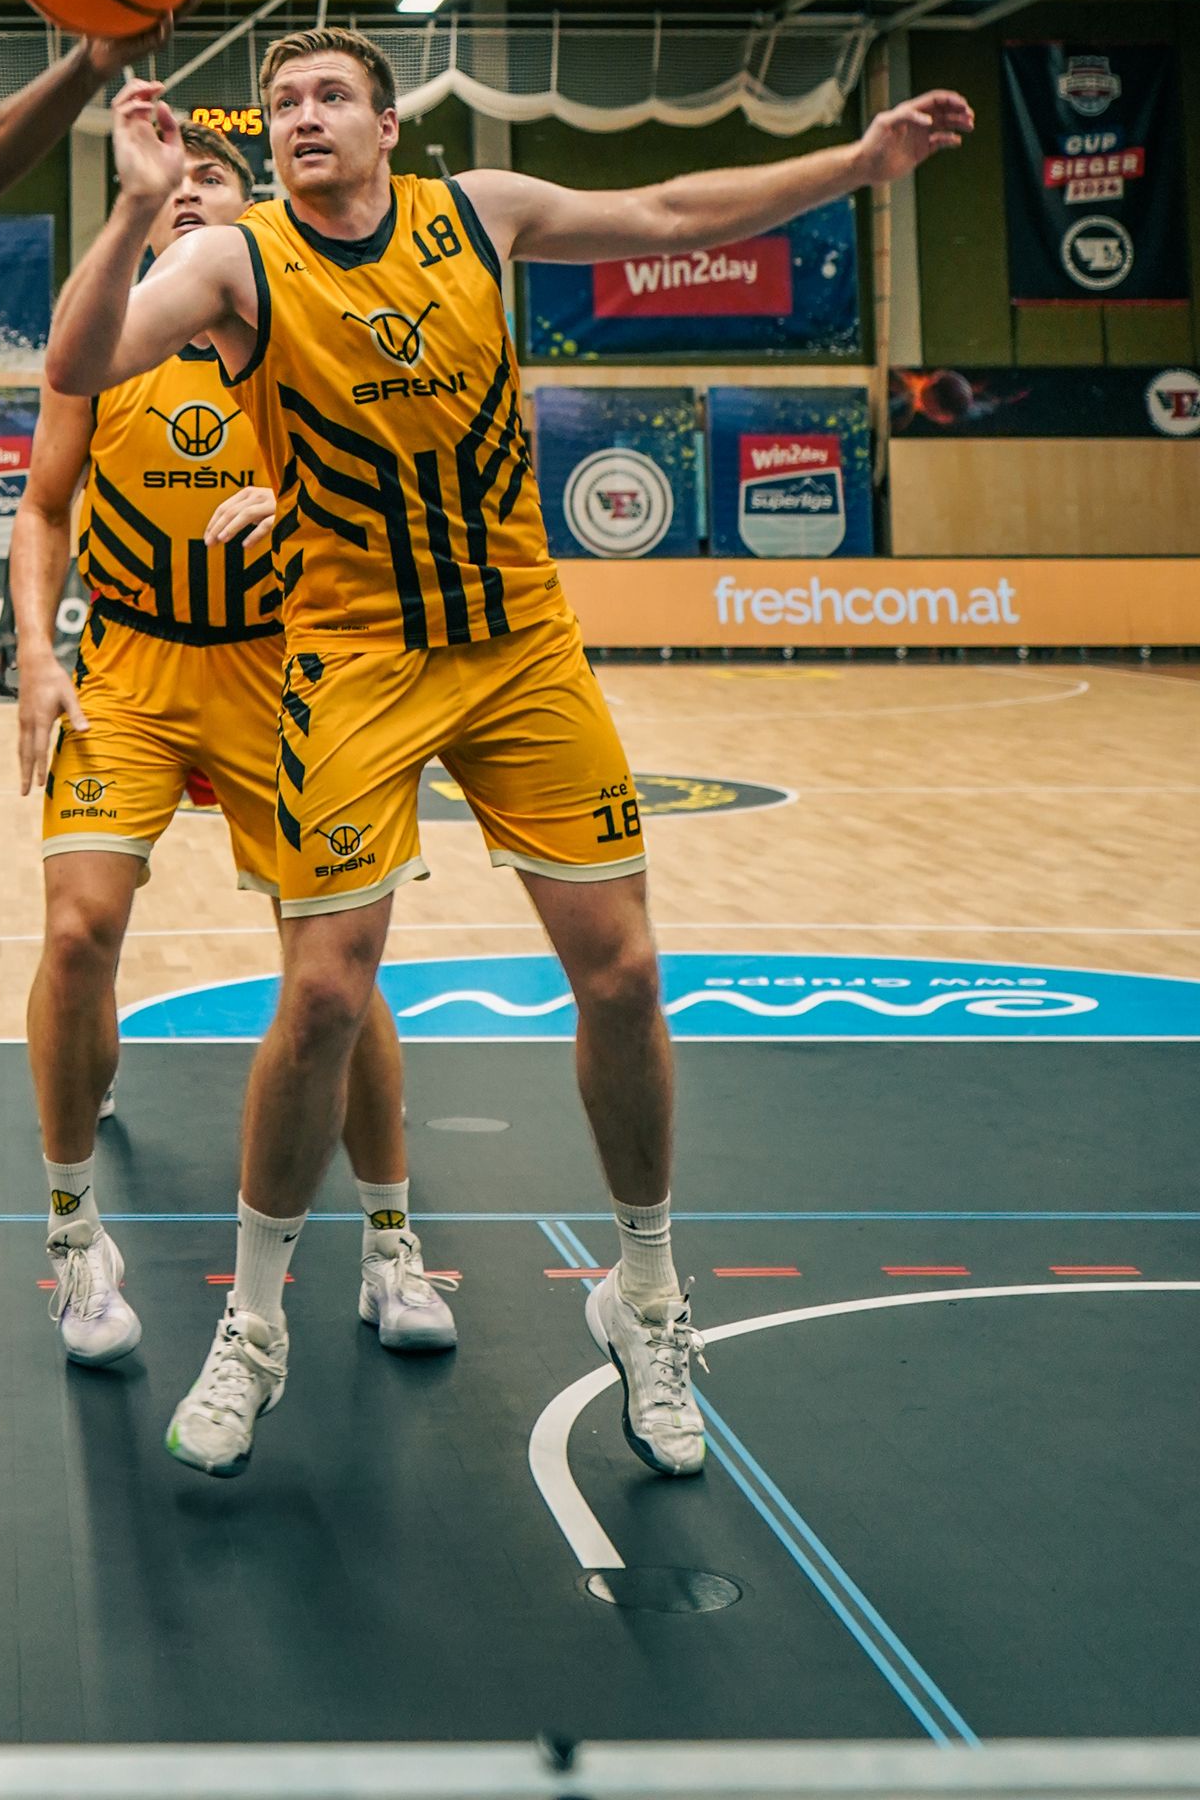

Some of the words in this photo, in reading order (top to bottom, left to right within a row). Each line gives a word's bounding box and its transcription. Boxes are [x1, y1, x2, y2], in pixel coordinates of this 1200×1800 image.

[412, 214, 462, 268] 18
[143, 466, 255, 488] SRŠNI
[714, 576, 1021, 625] freshcom.at
[60, 807, 117, 819] SRŠNI
[593, 799, 641, 843] 18
